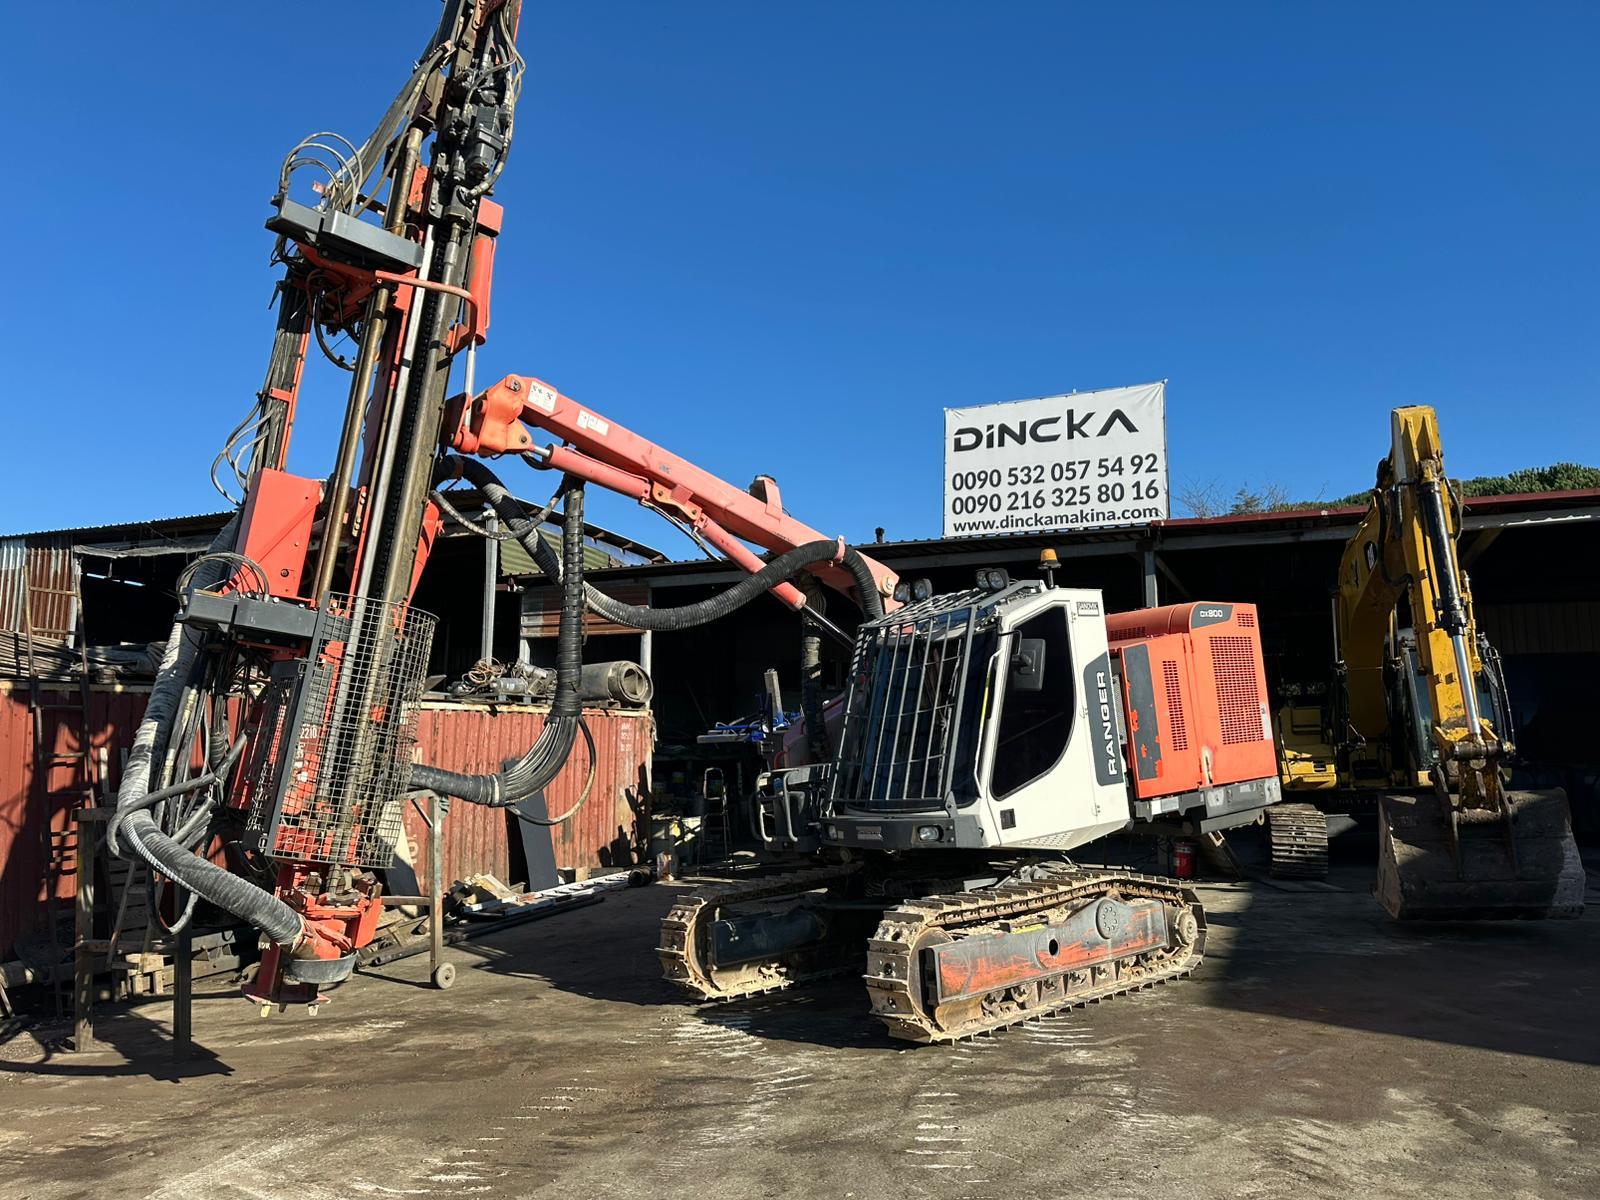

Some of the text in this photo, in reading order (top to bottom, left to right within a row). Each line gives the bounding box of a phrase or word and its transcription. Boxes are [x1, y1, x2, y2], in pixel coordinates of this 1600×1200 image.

[952, 453, 1159, 491] 0090 532 057 54 92
[952, 479, 1159, 515] 0090 216 325 80 16
[953, 506, 1160, 532] www.dinckamakina.com
[1096, 671, 1118, 775] RANGER
